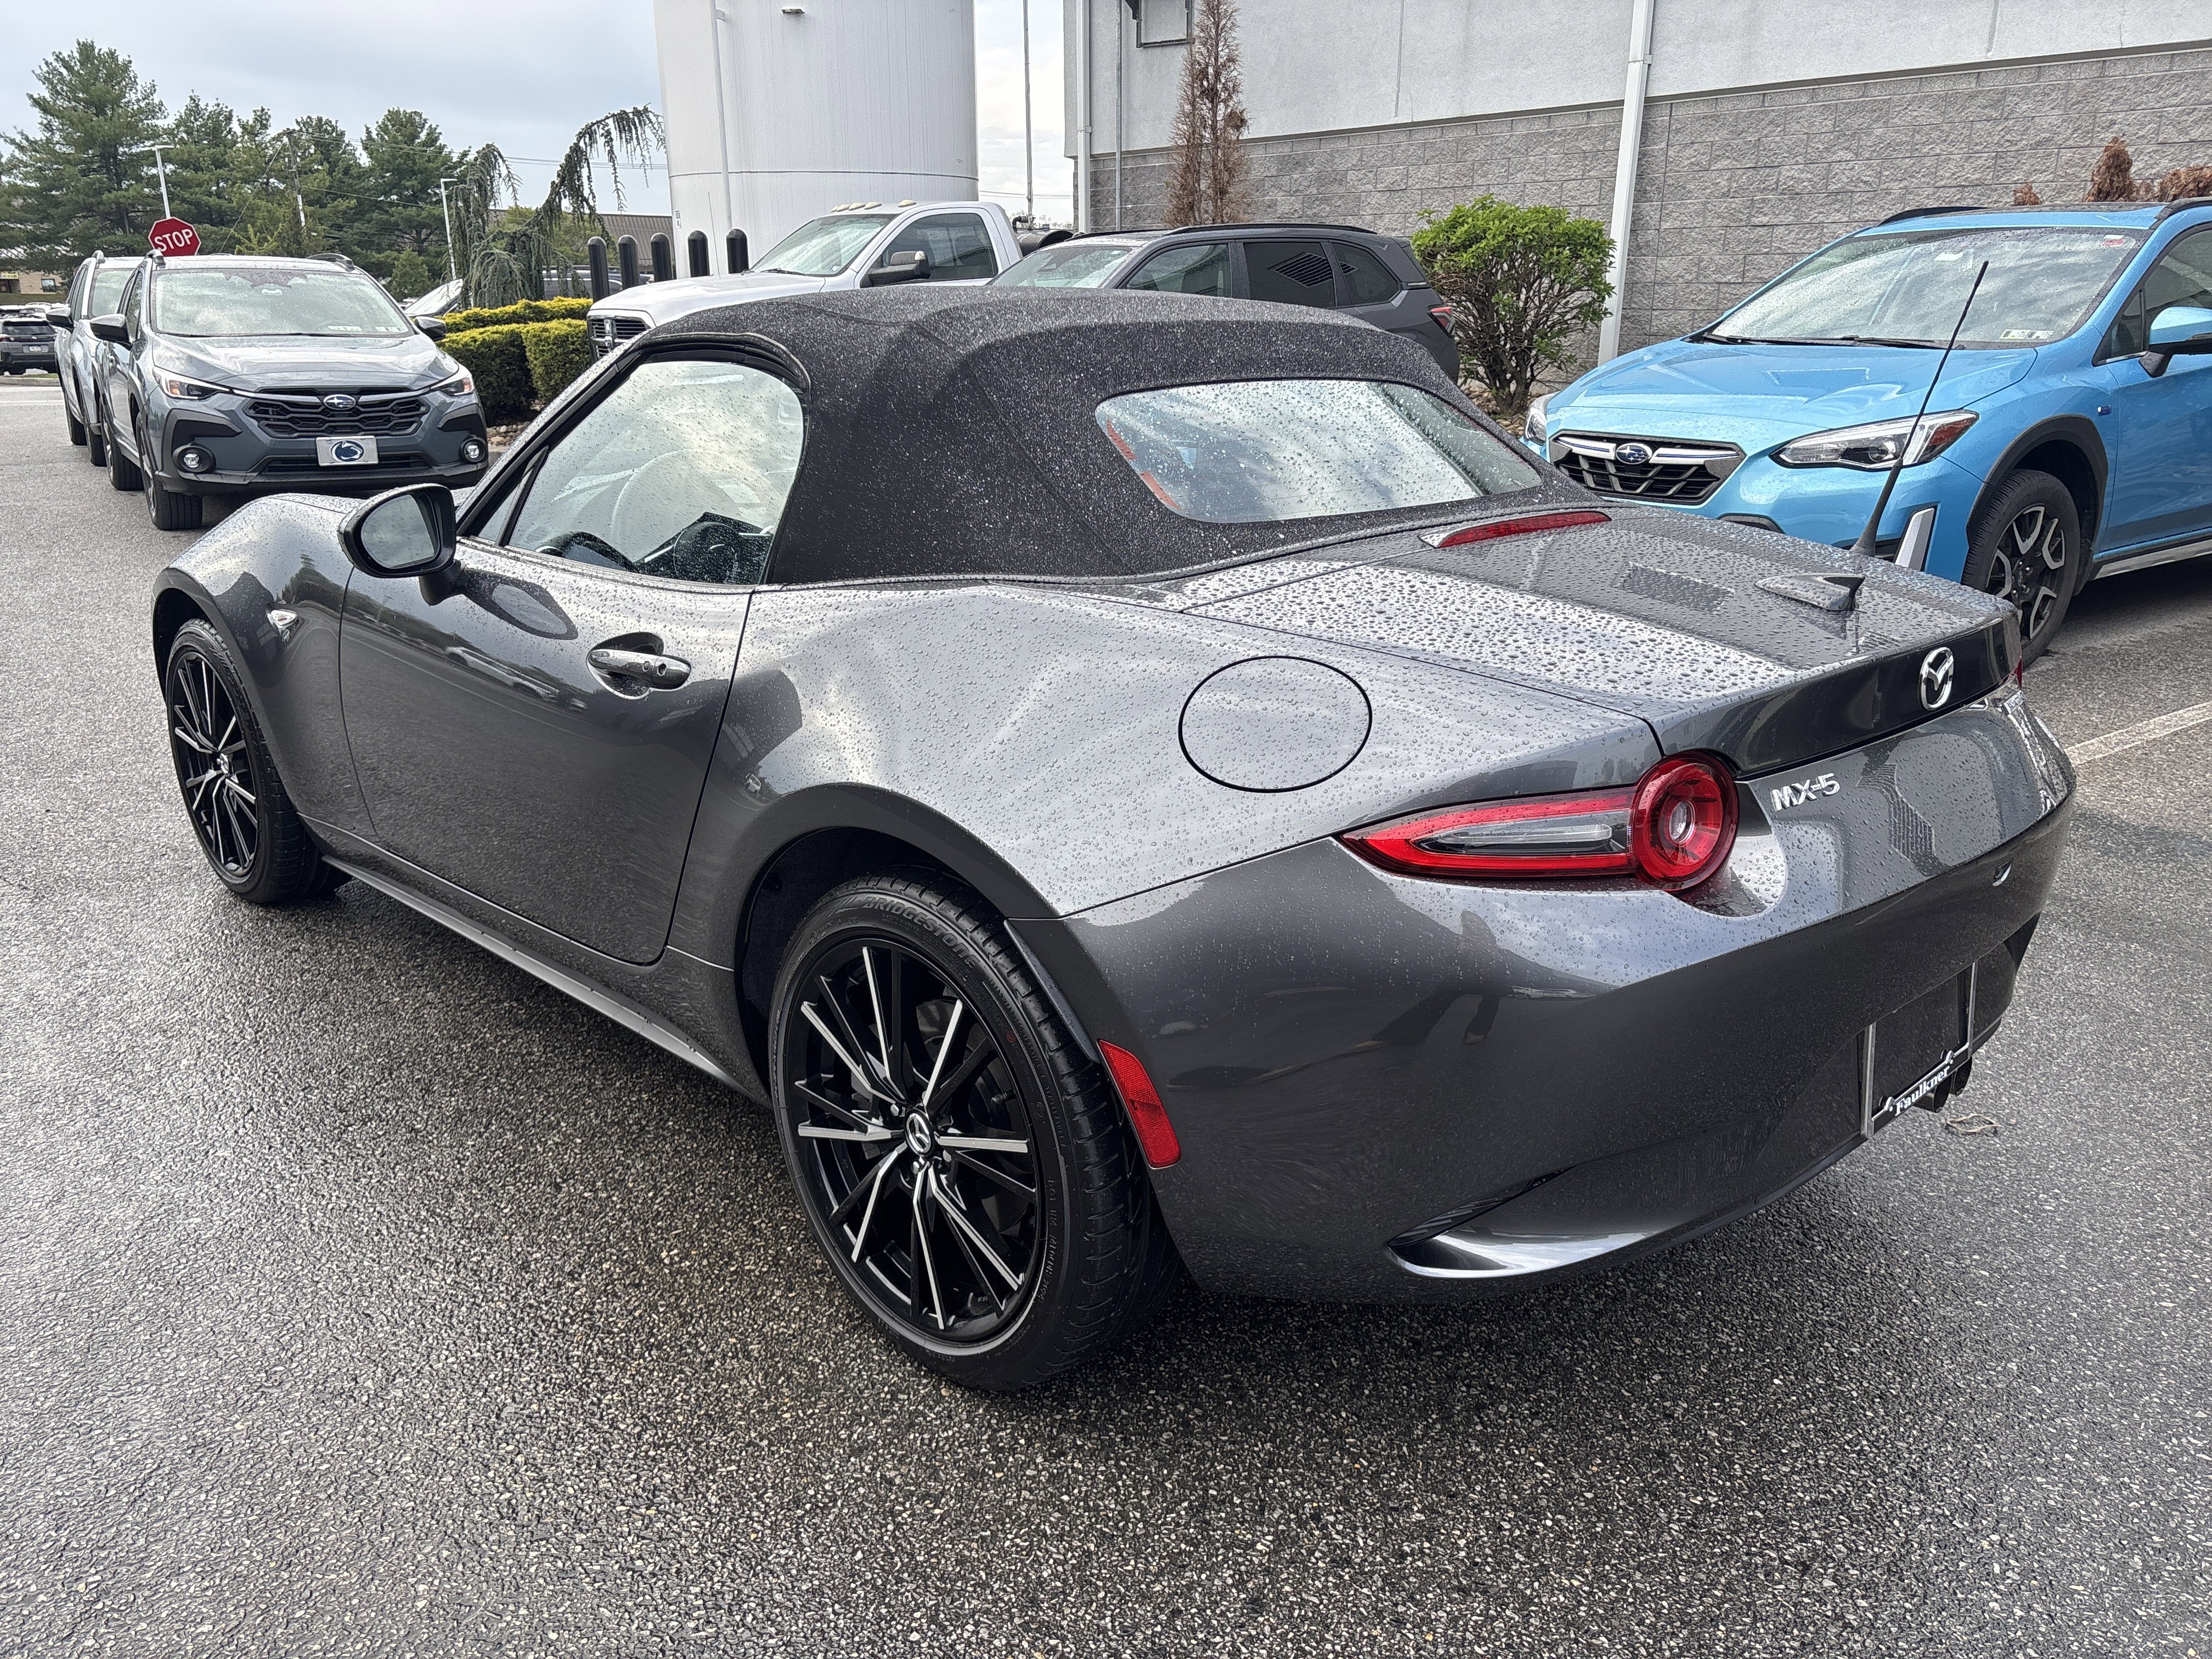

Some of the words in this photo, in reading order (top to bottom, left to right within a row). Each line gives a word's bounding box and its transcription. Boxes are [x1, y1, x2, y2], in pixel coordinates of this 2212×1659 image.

[154, 229, 193, 252] STOP
[1771, 772, 1840, 812] MX-5
[862, 896, 981, 969] BRIDGESTONE
[1894, 1065, 1950, 1116] Faulkner
